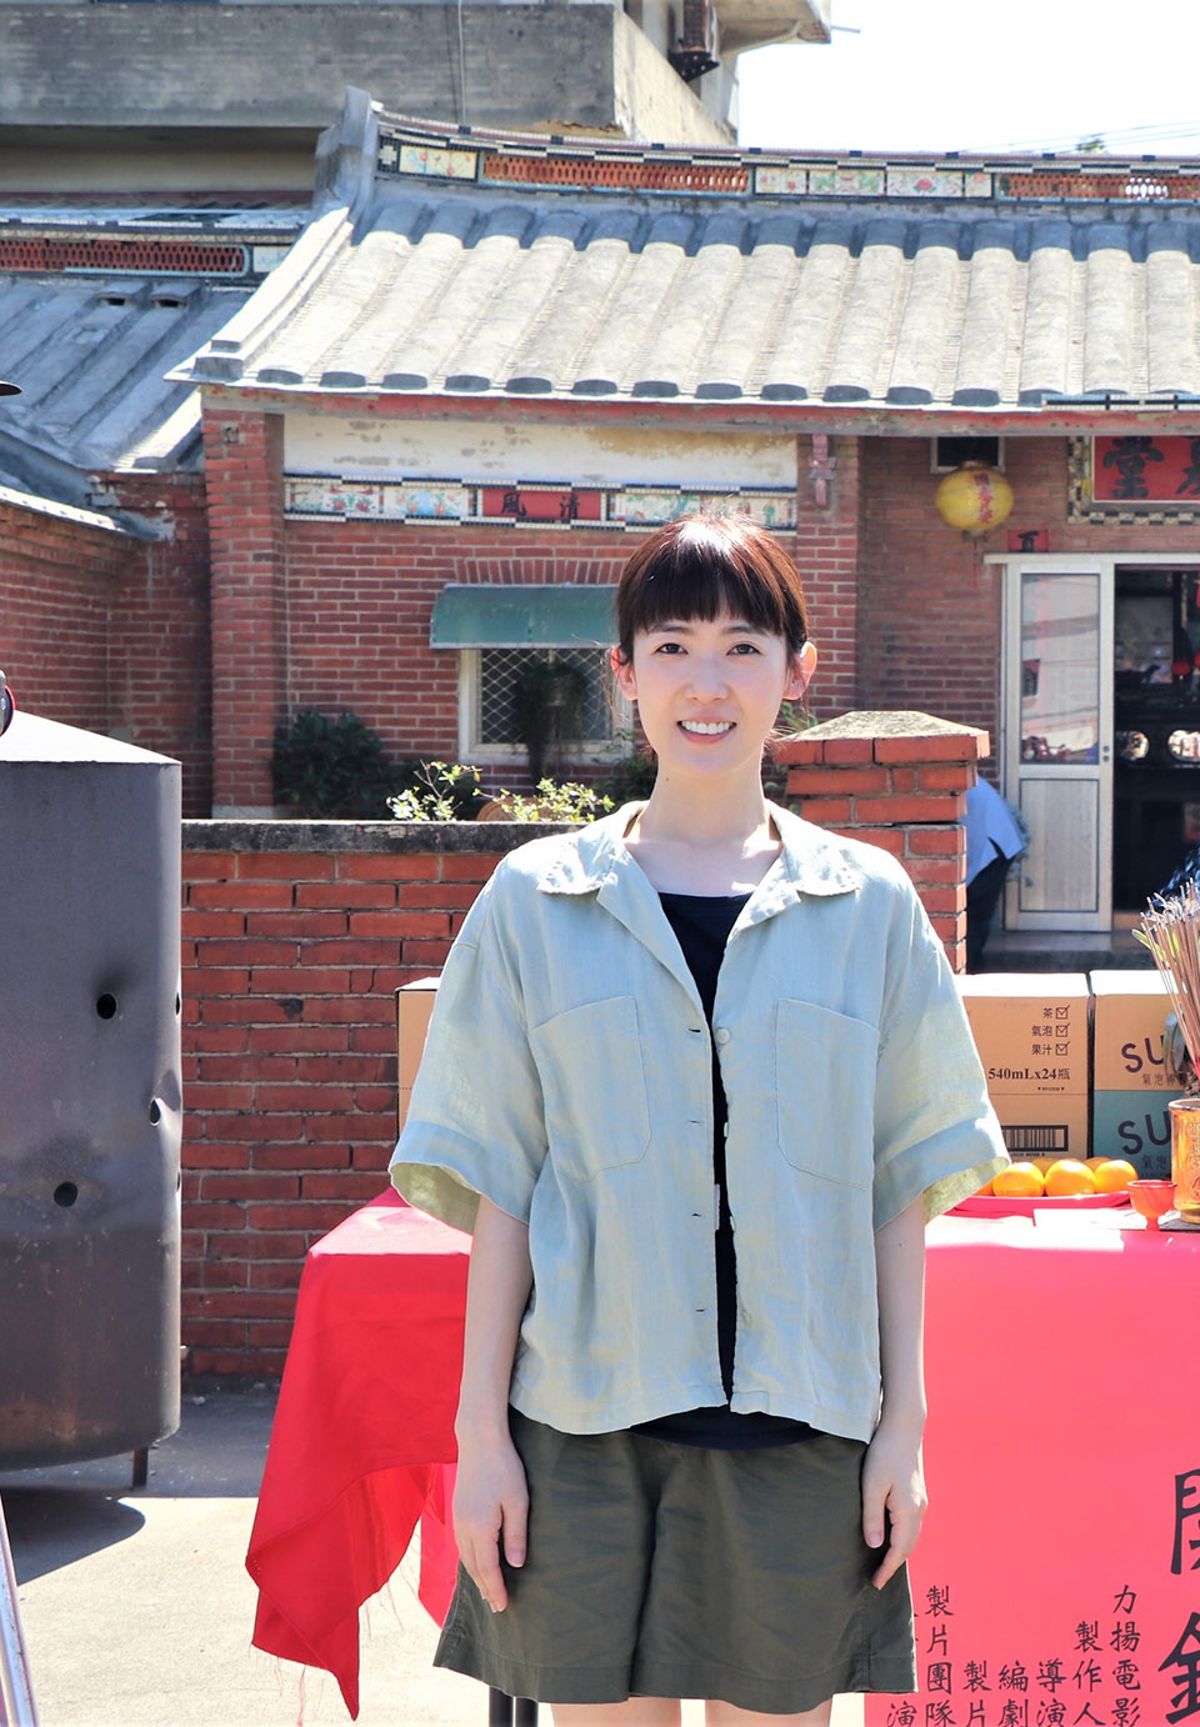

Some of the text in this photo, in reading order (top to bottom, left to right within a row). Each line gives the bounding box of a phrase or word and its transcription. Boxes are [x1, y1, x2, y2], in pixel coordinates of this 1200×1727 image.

[1032, 1025, 1053, 1037] 氣泡
[1043, 1008, 1053, 1018] 茶
[988, 1068, 1070, 1080] 540mLx24瓶
[1032, 1044, 1053, 1055] 果汁
[1121, 1034, 1165, 1073] SU
[924, 1585, 956, 1727] 製片團隊
[1072, 1620, 1106, 1726] 製作人
[1110, 1585, 1142, 1727] 力揚電影
[963, 1660, 993, 1727] 製片
[998, 1660, 1029, 1727] 編劇
[1035, 1657, 1067, 1727] 導演
